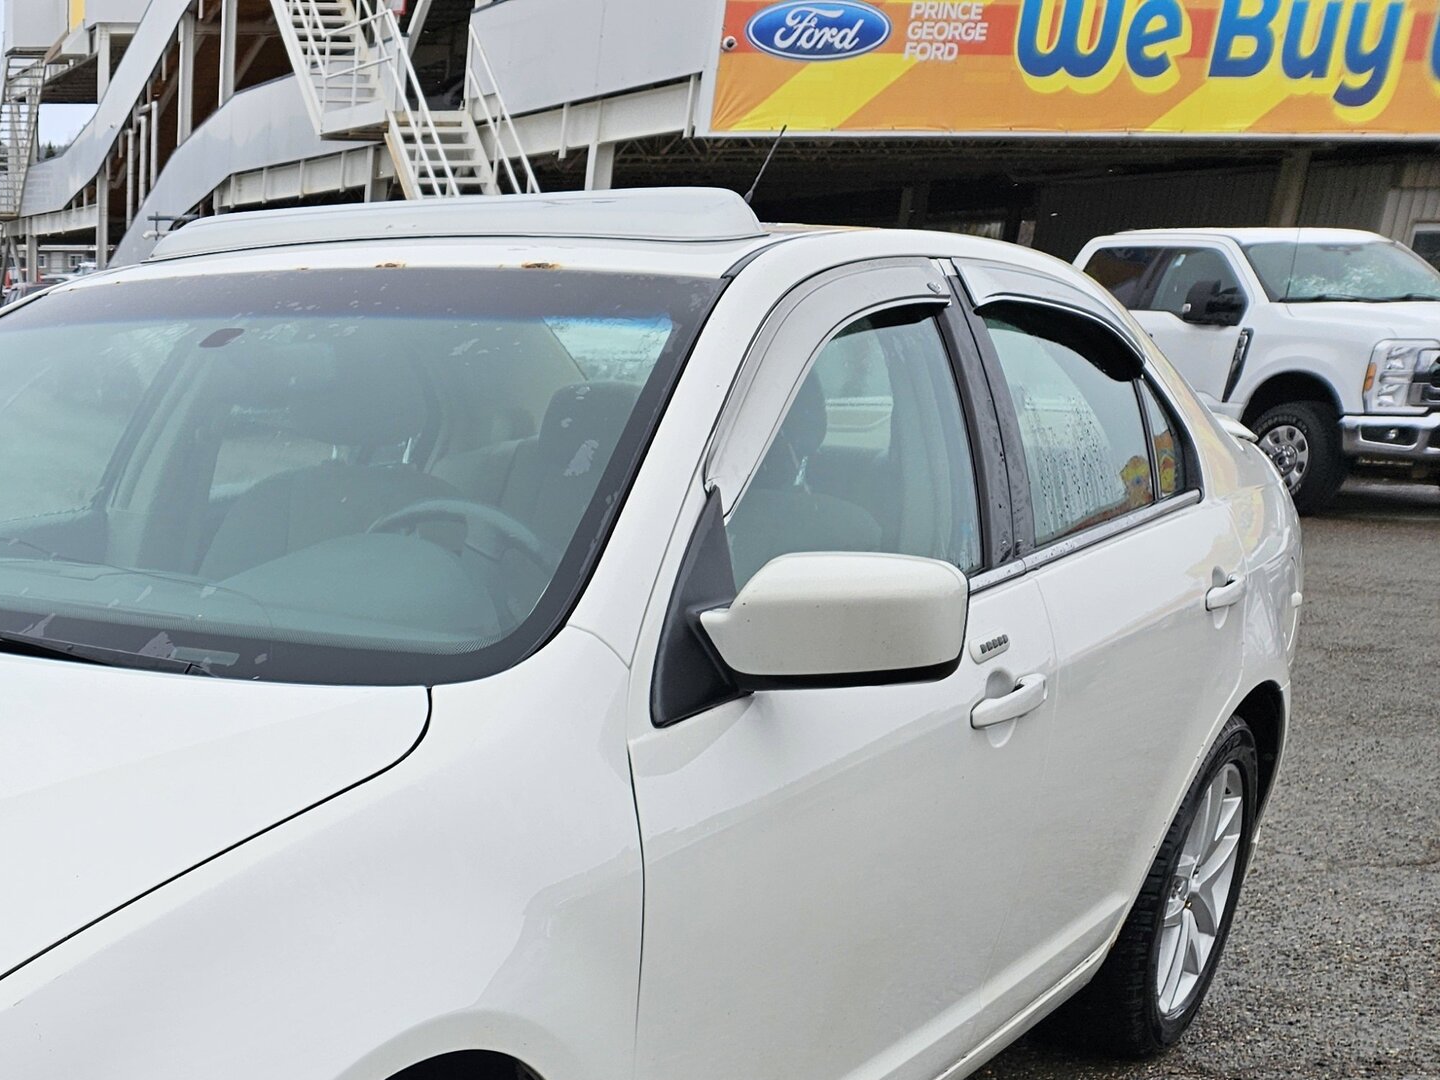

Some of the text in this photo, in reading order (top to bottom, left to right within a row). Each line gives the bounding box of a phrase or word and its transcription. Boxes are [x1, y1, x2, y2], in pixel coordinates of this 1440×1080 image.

[911, 1, 984, 20] PRINCE
[773, 6, 865, 50] Ford
[907, 21, 989, 42] GEORGE
[903, 42, 959, 62] FORD
[1016, 0, 1184, 79] We
[1207, 0, 1405, 108] Buy
